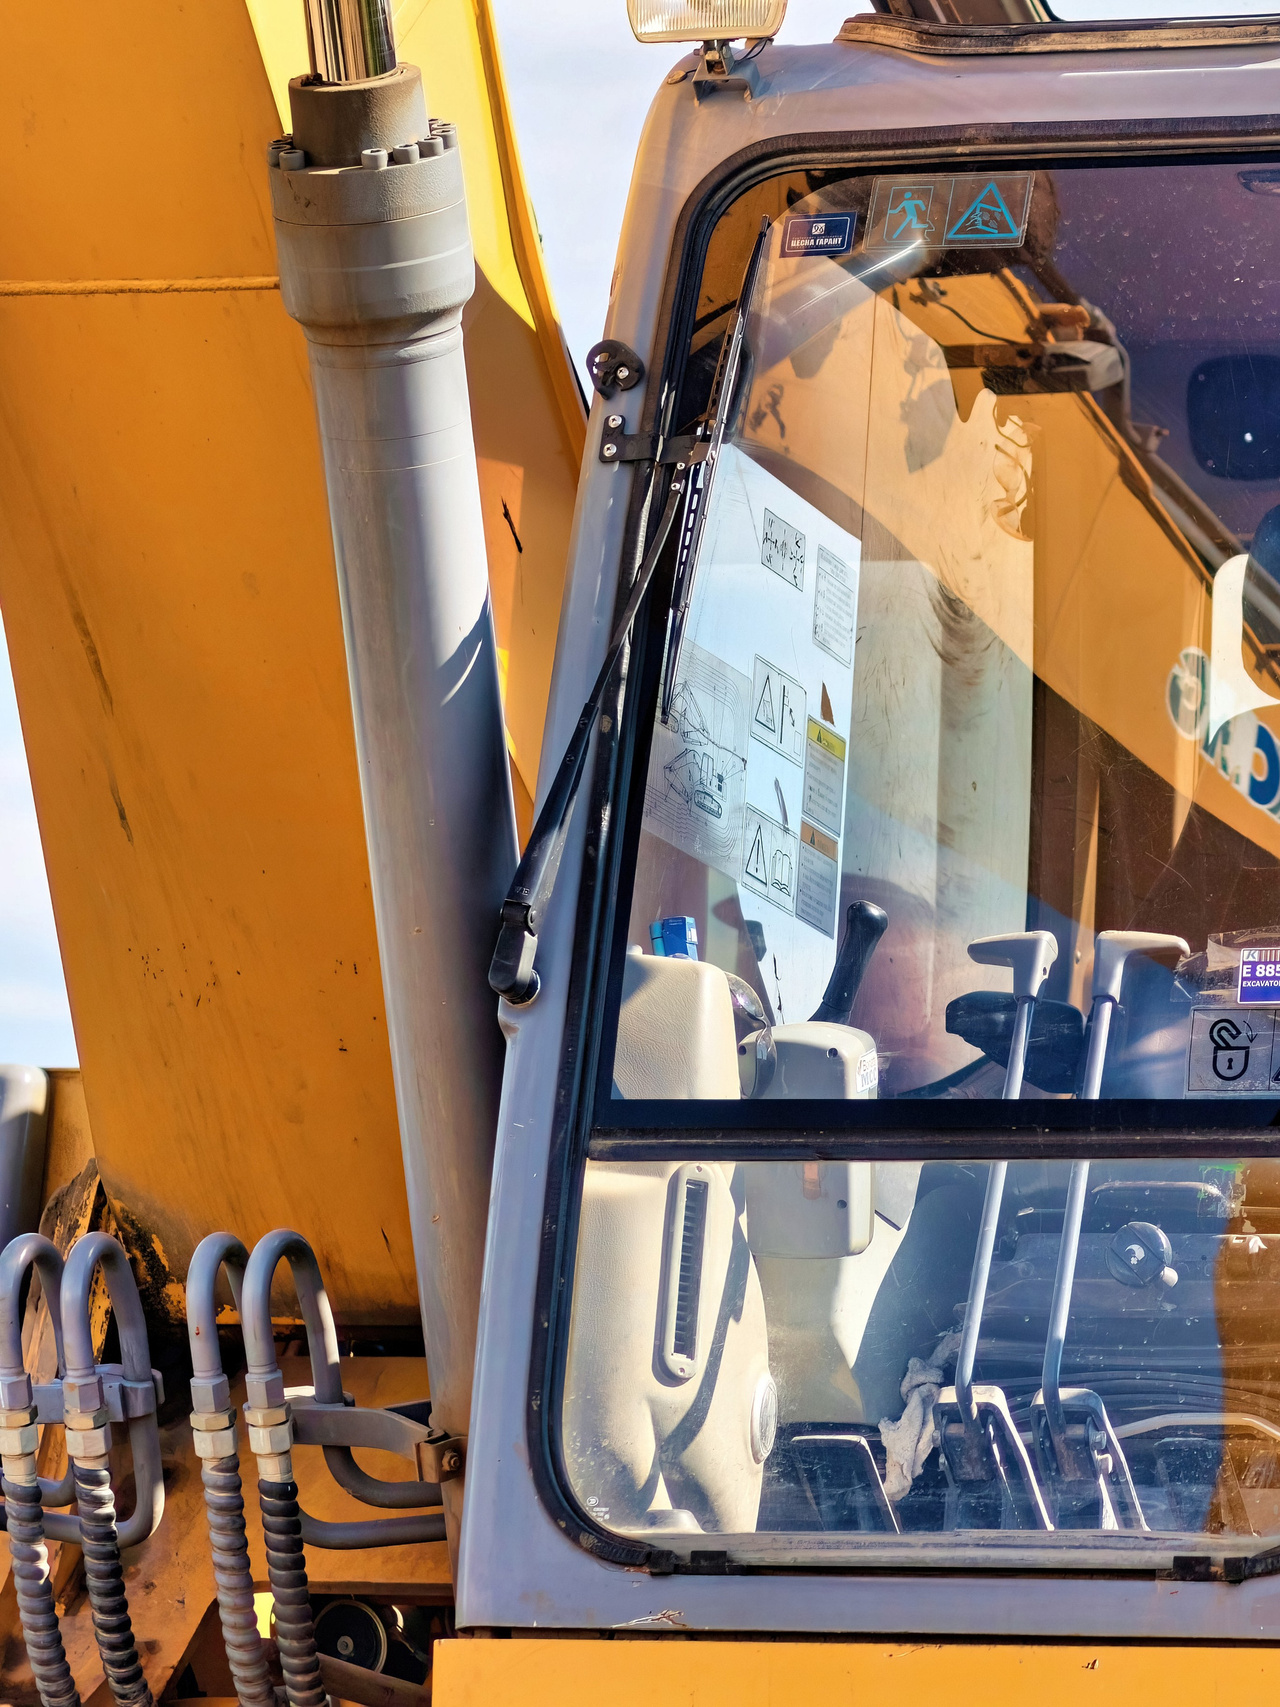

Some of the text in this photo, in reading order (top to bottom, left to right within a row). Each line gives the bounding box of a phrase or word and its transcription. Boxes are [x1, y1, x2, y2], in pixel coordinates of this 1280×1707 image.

[791, 239, 815, 247] ЦЕСНА
[815, 237, 842, 246] ГАРАНТ
[1242, 965, 1252, 977] E
